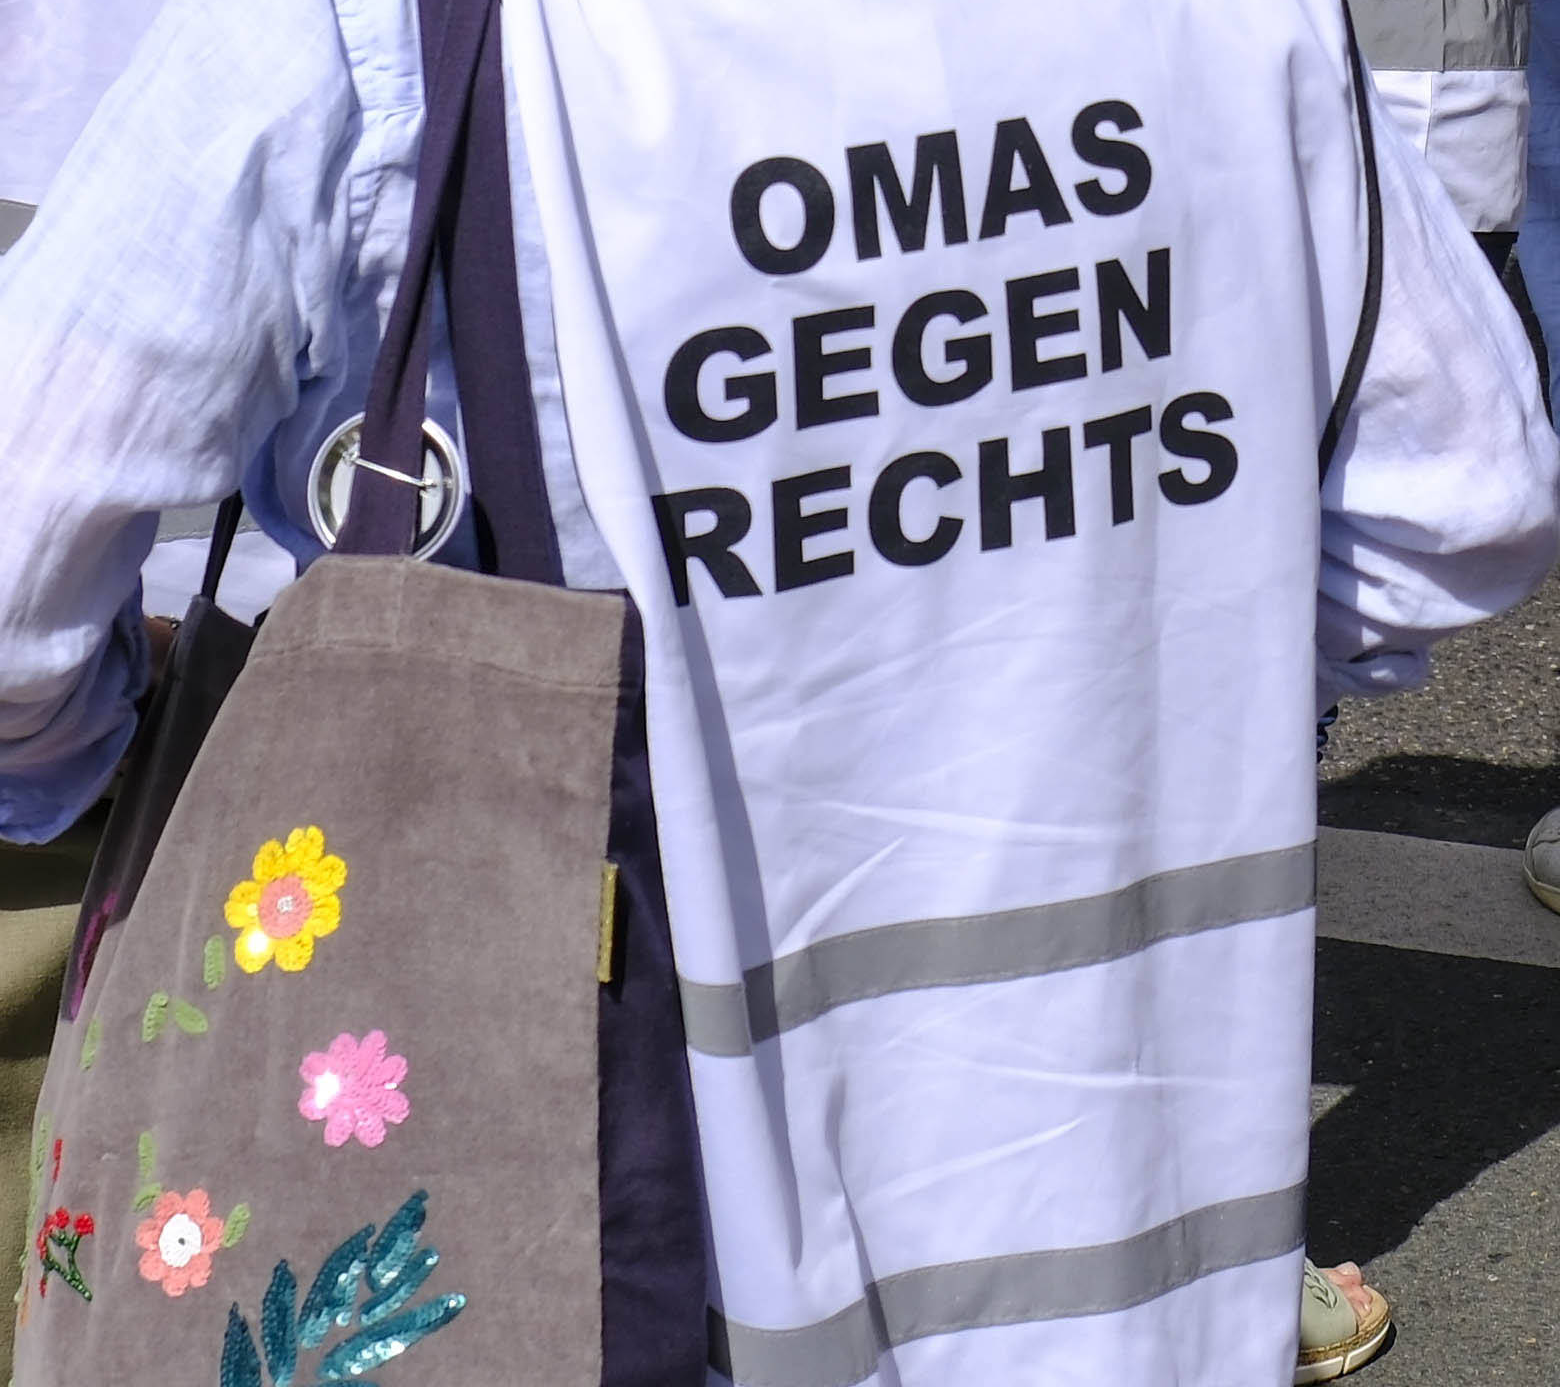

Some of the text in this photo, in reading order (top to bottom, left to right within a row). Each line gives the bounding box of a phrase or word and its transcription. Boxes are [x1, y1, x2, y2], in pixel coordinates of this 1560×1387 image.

[728, 98, 1153, 276] OMAS
[663, 246, 1172, 444] GEGEN
[651, 390, 1240, 608] RECHTS
